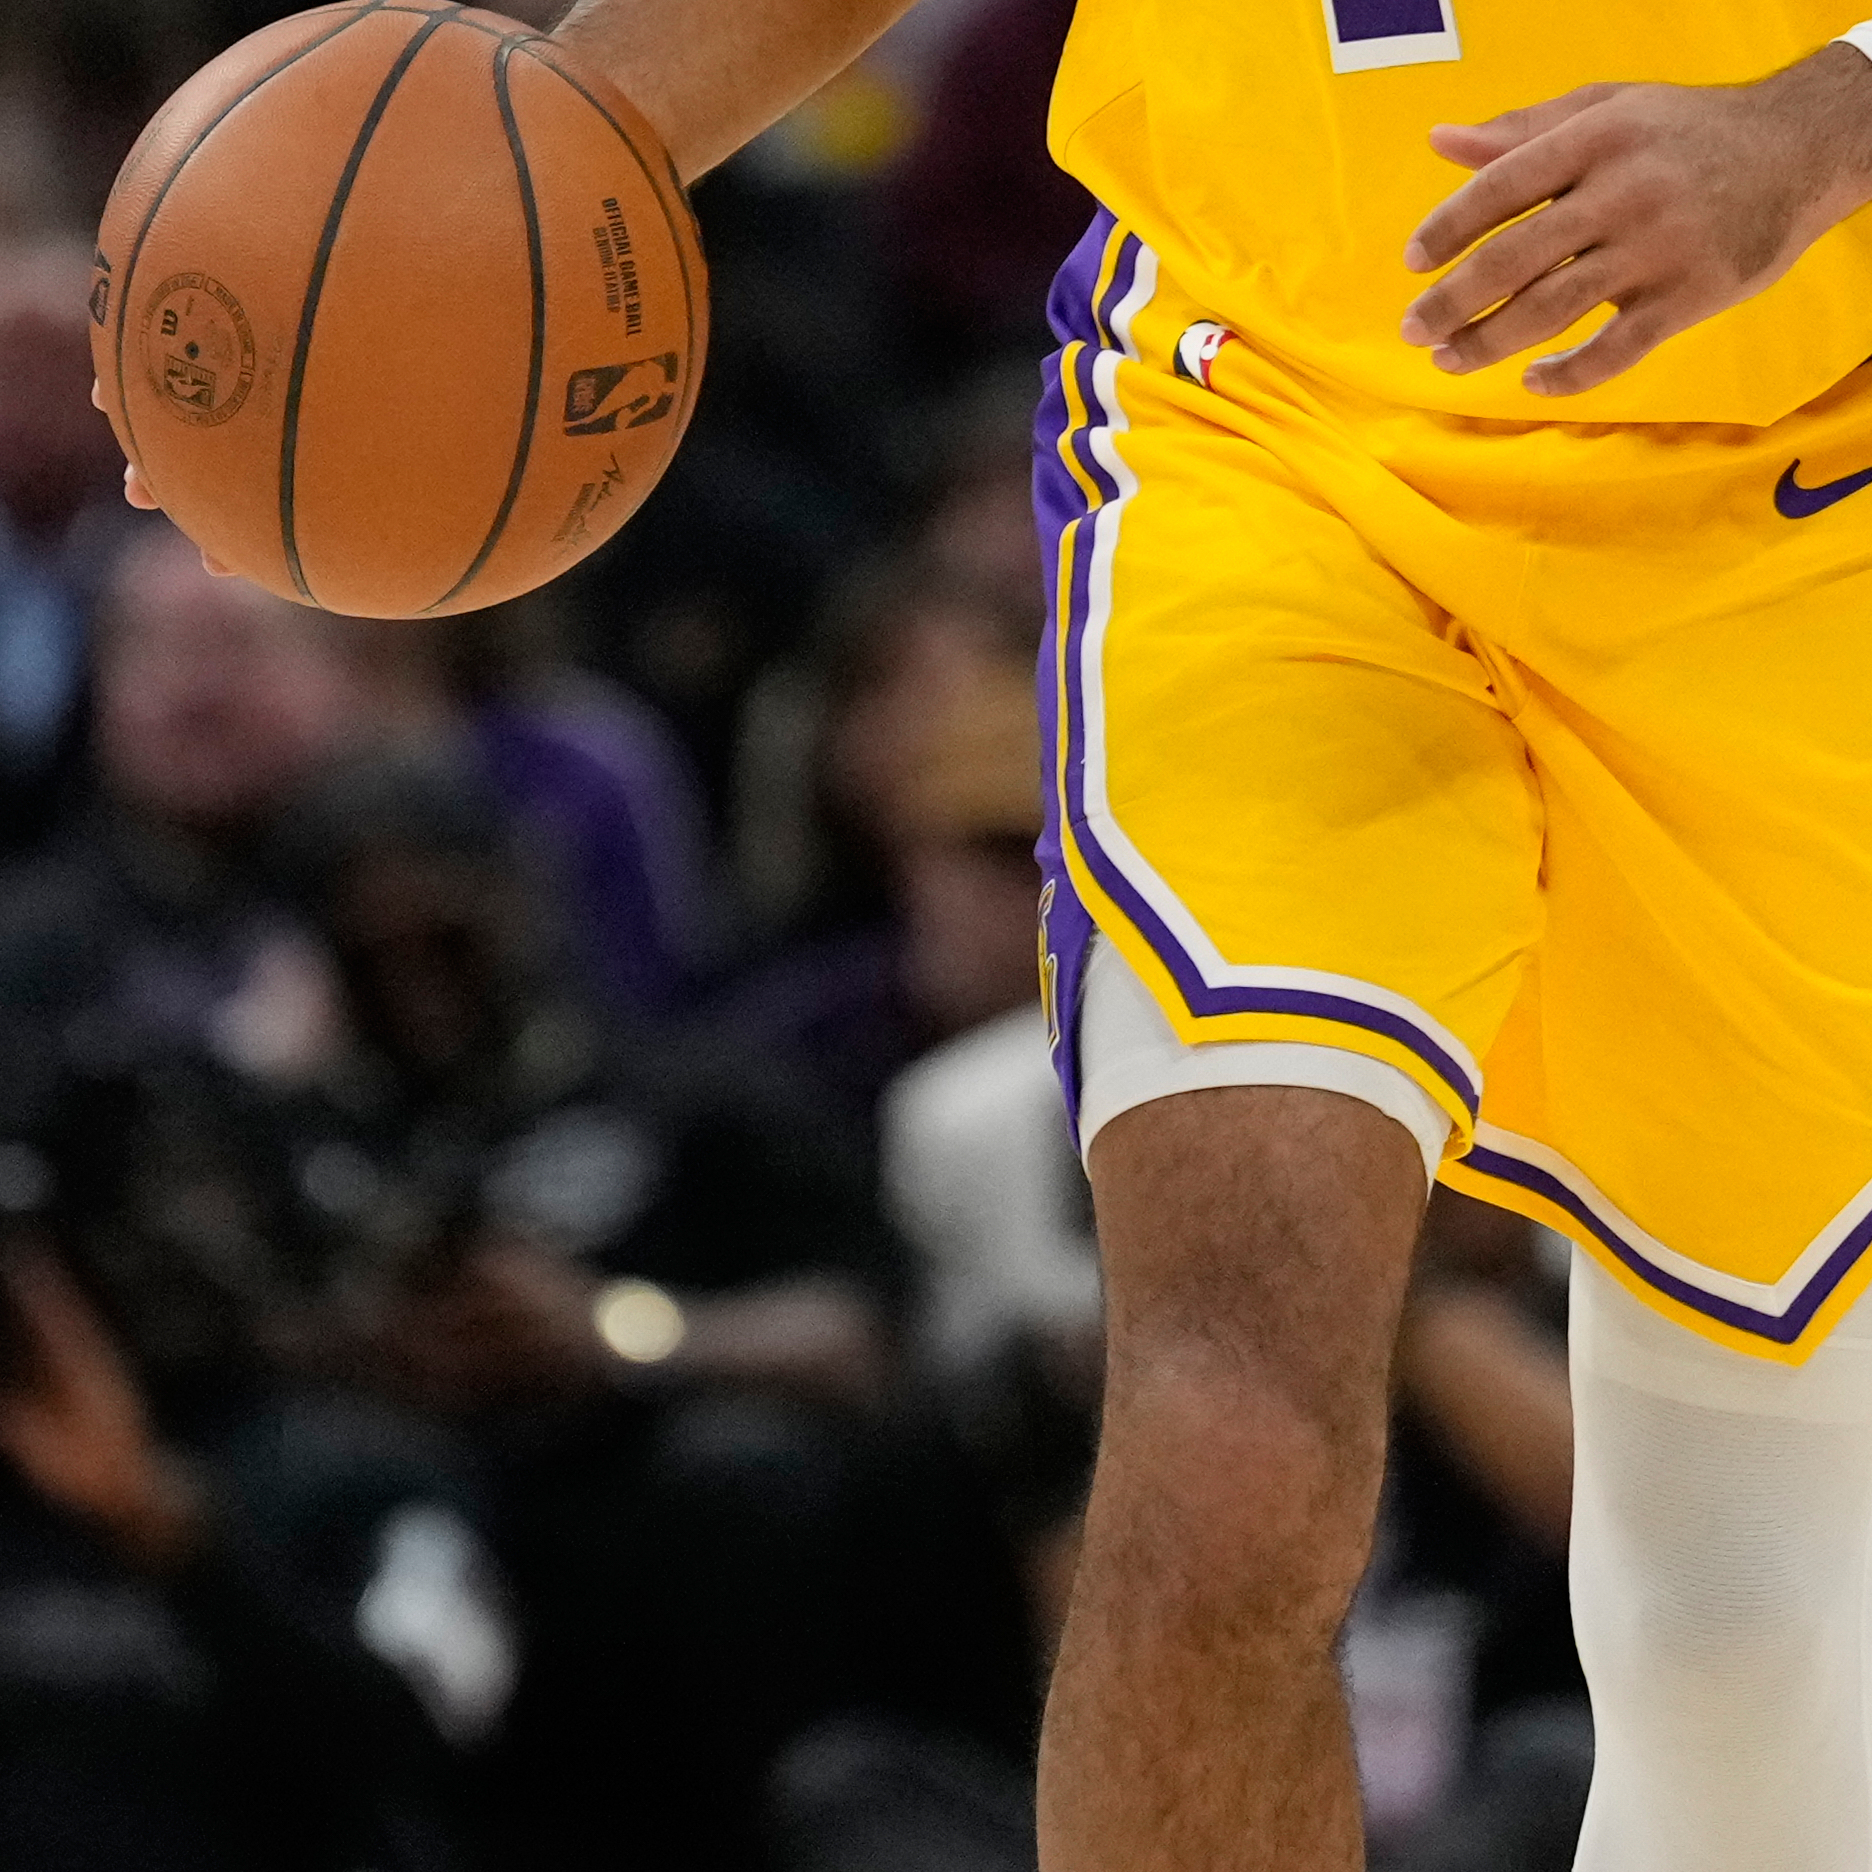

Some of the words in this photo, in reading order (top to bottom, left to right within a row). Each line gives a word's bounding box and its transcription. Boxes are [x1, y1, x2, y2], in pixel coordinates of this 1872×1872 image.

[602, 197, 632, 256] OFFICIAL
[619, 260, 640, 298] GAME
[626, 302, 642, 338] BALL
